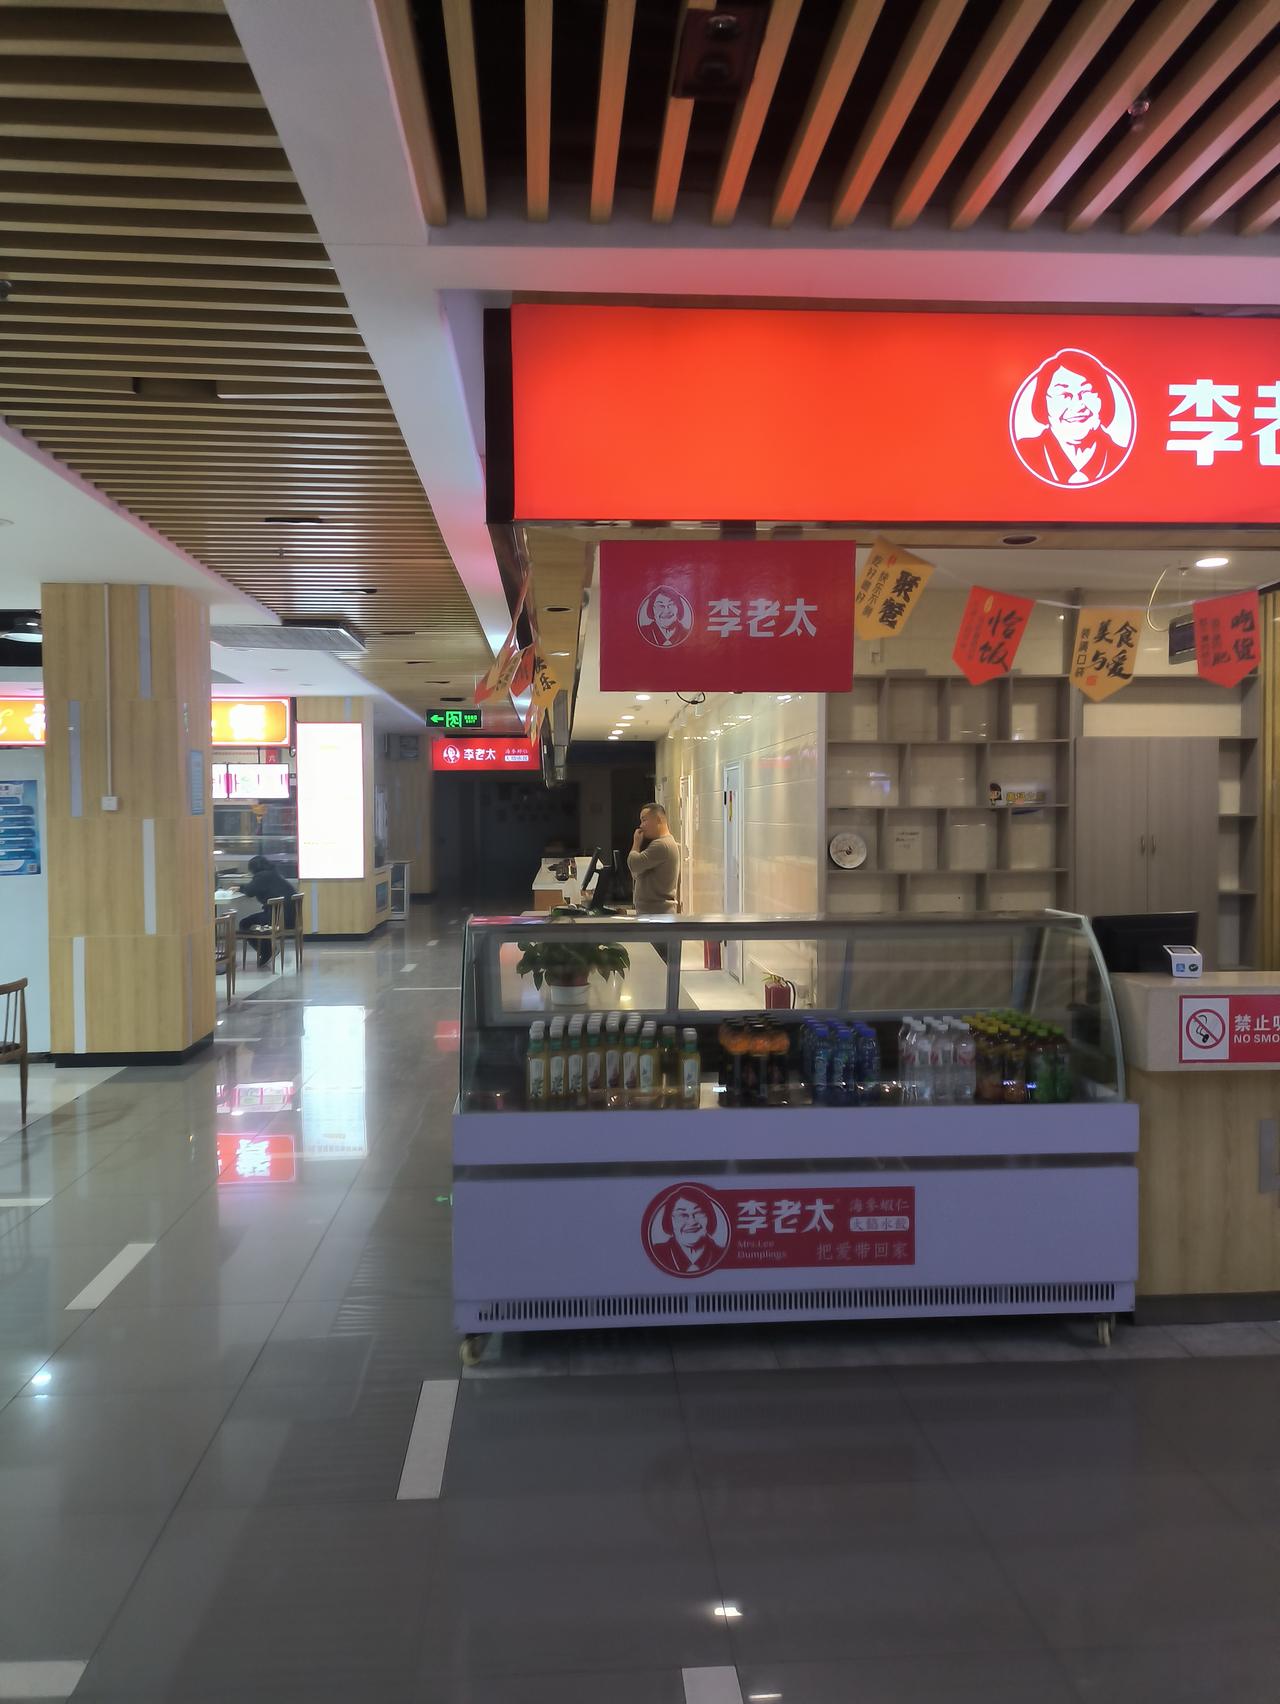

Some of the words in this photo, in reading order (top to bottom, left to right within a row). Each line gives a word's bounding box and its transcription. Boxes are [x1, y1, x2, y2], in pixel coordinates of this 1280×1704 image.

[879, 570, 921, 629] 聚餐
[706, 597, 818, 638] 李老太
[463, 748, 496, 761] 李老太
[1234, 1034, 1251, 1044] NO
[736, 1198, 835, 1235] 李老太
[736, 1249, 787, 1260] Dumplings
